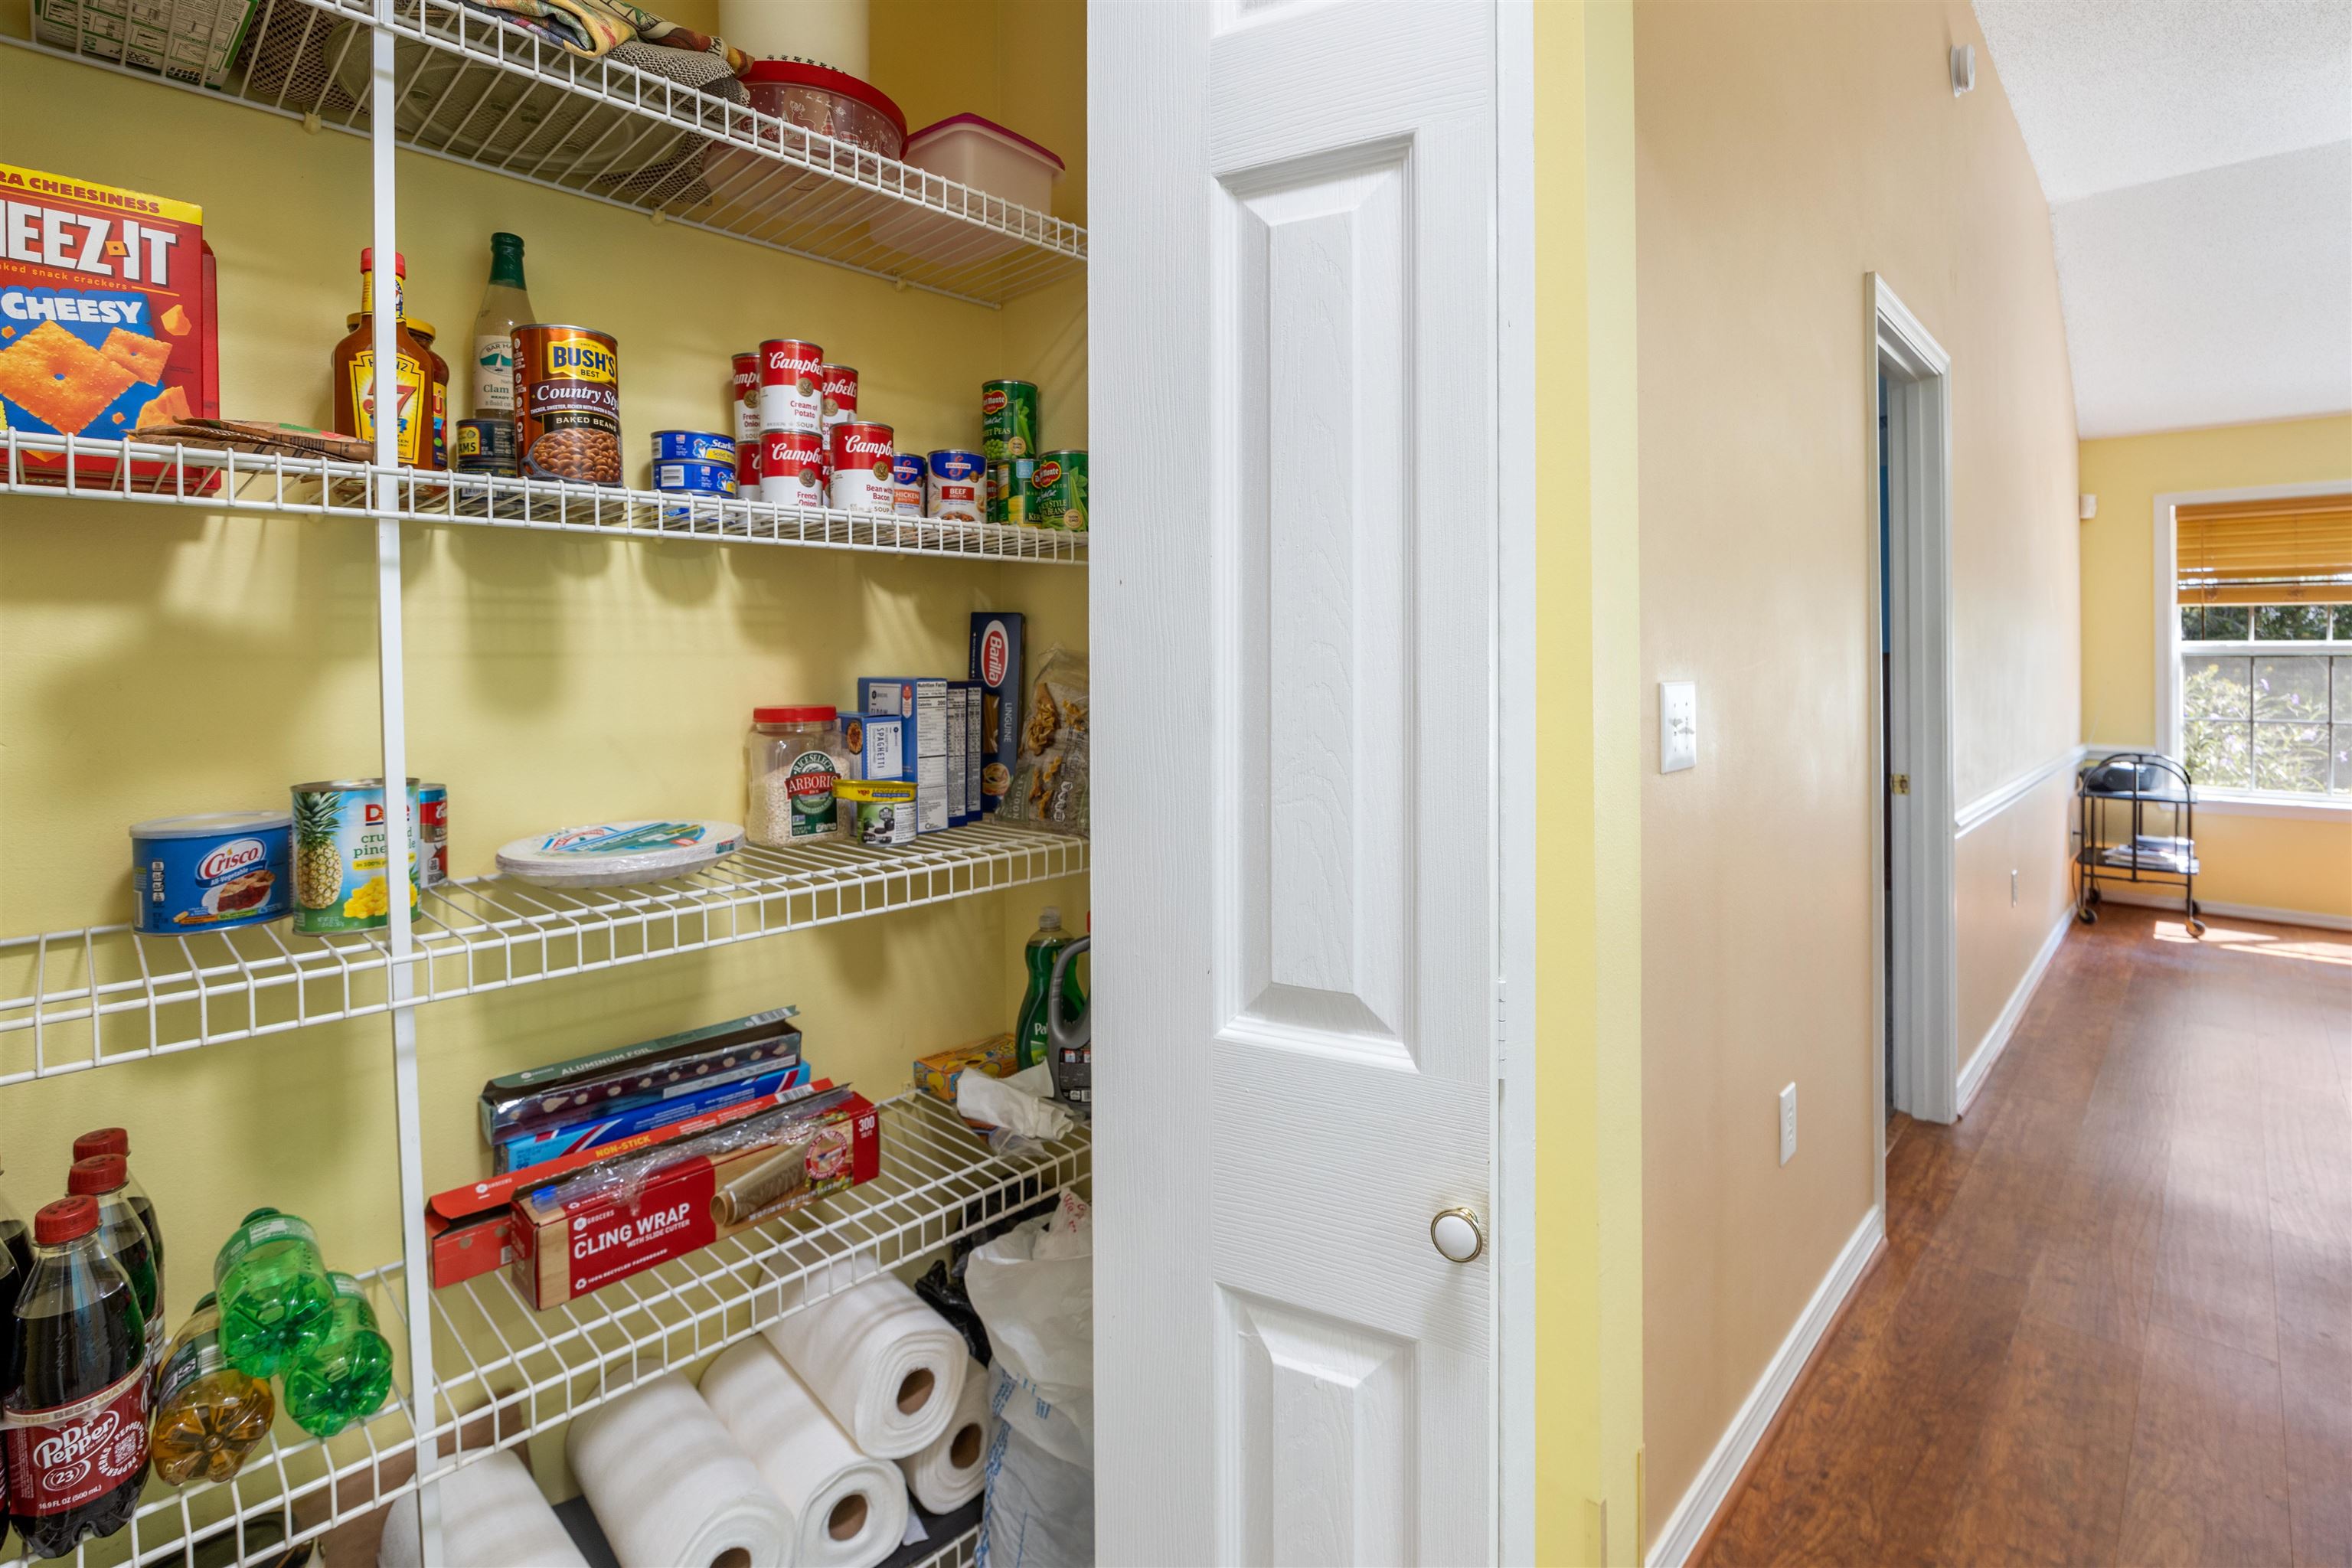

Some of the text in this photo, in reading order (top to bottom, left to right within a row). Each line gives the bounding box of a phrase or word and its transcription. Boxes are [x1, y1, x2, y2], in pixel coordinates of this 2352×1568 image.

[29, 178, 159, 214] CHEESINESS
[0, 263, 128, 290] ked snack crackers
[1, 292, 142, 324] CHEESY
[553, 346, 615, 378] BUSH'S
[580, 369, 599, 378] BEST
[483, 384, 509, 394] Clam
[537, 385, 601, 403] Country
[790, 400, 811, 409] Cream
[794, 409, 815, 419] Potato
[593, 418, 616, 432] BEANS
[797, 491, 818, 499] French
[866, 484, 893, 495] Bean with
[872, 492, 890, 501] Bacon
[799, 498, 817, 507] Onion
[874, 505, 890, 514] SOUP
[1047, 508, 1067, 516] BEANS
[988, 635, 1002, 682] Barilla
[1004, 702, 1013, 743] LINGUINE
[876, 727, 885, 769] SPAGHETTI
[361, 827, 412, 844] crud
[353, 839, 416, 858] pinele
[204, 848, 259, 878] Crisco
[211, 867, 249, 886] All-Vegetable
[561, 1054, 625, 1076] ALUMINUM
[627, 1047, 653, 1057] FOIL
[858, 1115, 875, 1132] 300
[595, 1135, 652, 1158] NON-STICK
[586, 1209, 615, 1224] GROCERS
[574, 1202, 690, 1259] CLING WRAP
[626, 1219, 691, 1249] WITH SLIDE CUTTER
[603, 1262, 631, 1279] RECYCLED
[632, 1249, 668, 1266] PAPERBOARD
[54, 1401, 94, 1419] BEST
[98, 1383, 126, 1403] WAY
[41, 1417, 114, 1469] Pepper
[62, 1421, 94, 1449] Dr
[56, 1470, 74, 1485] 23
[62, 1496, 73, 1504] OZ
[73, 1491, 88, 1501] (500
[88, 1484, 102, 1495] mL)
